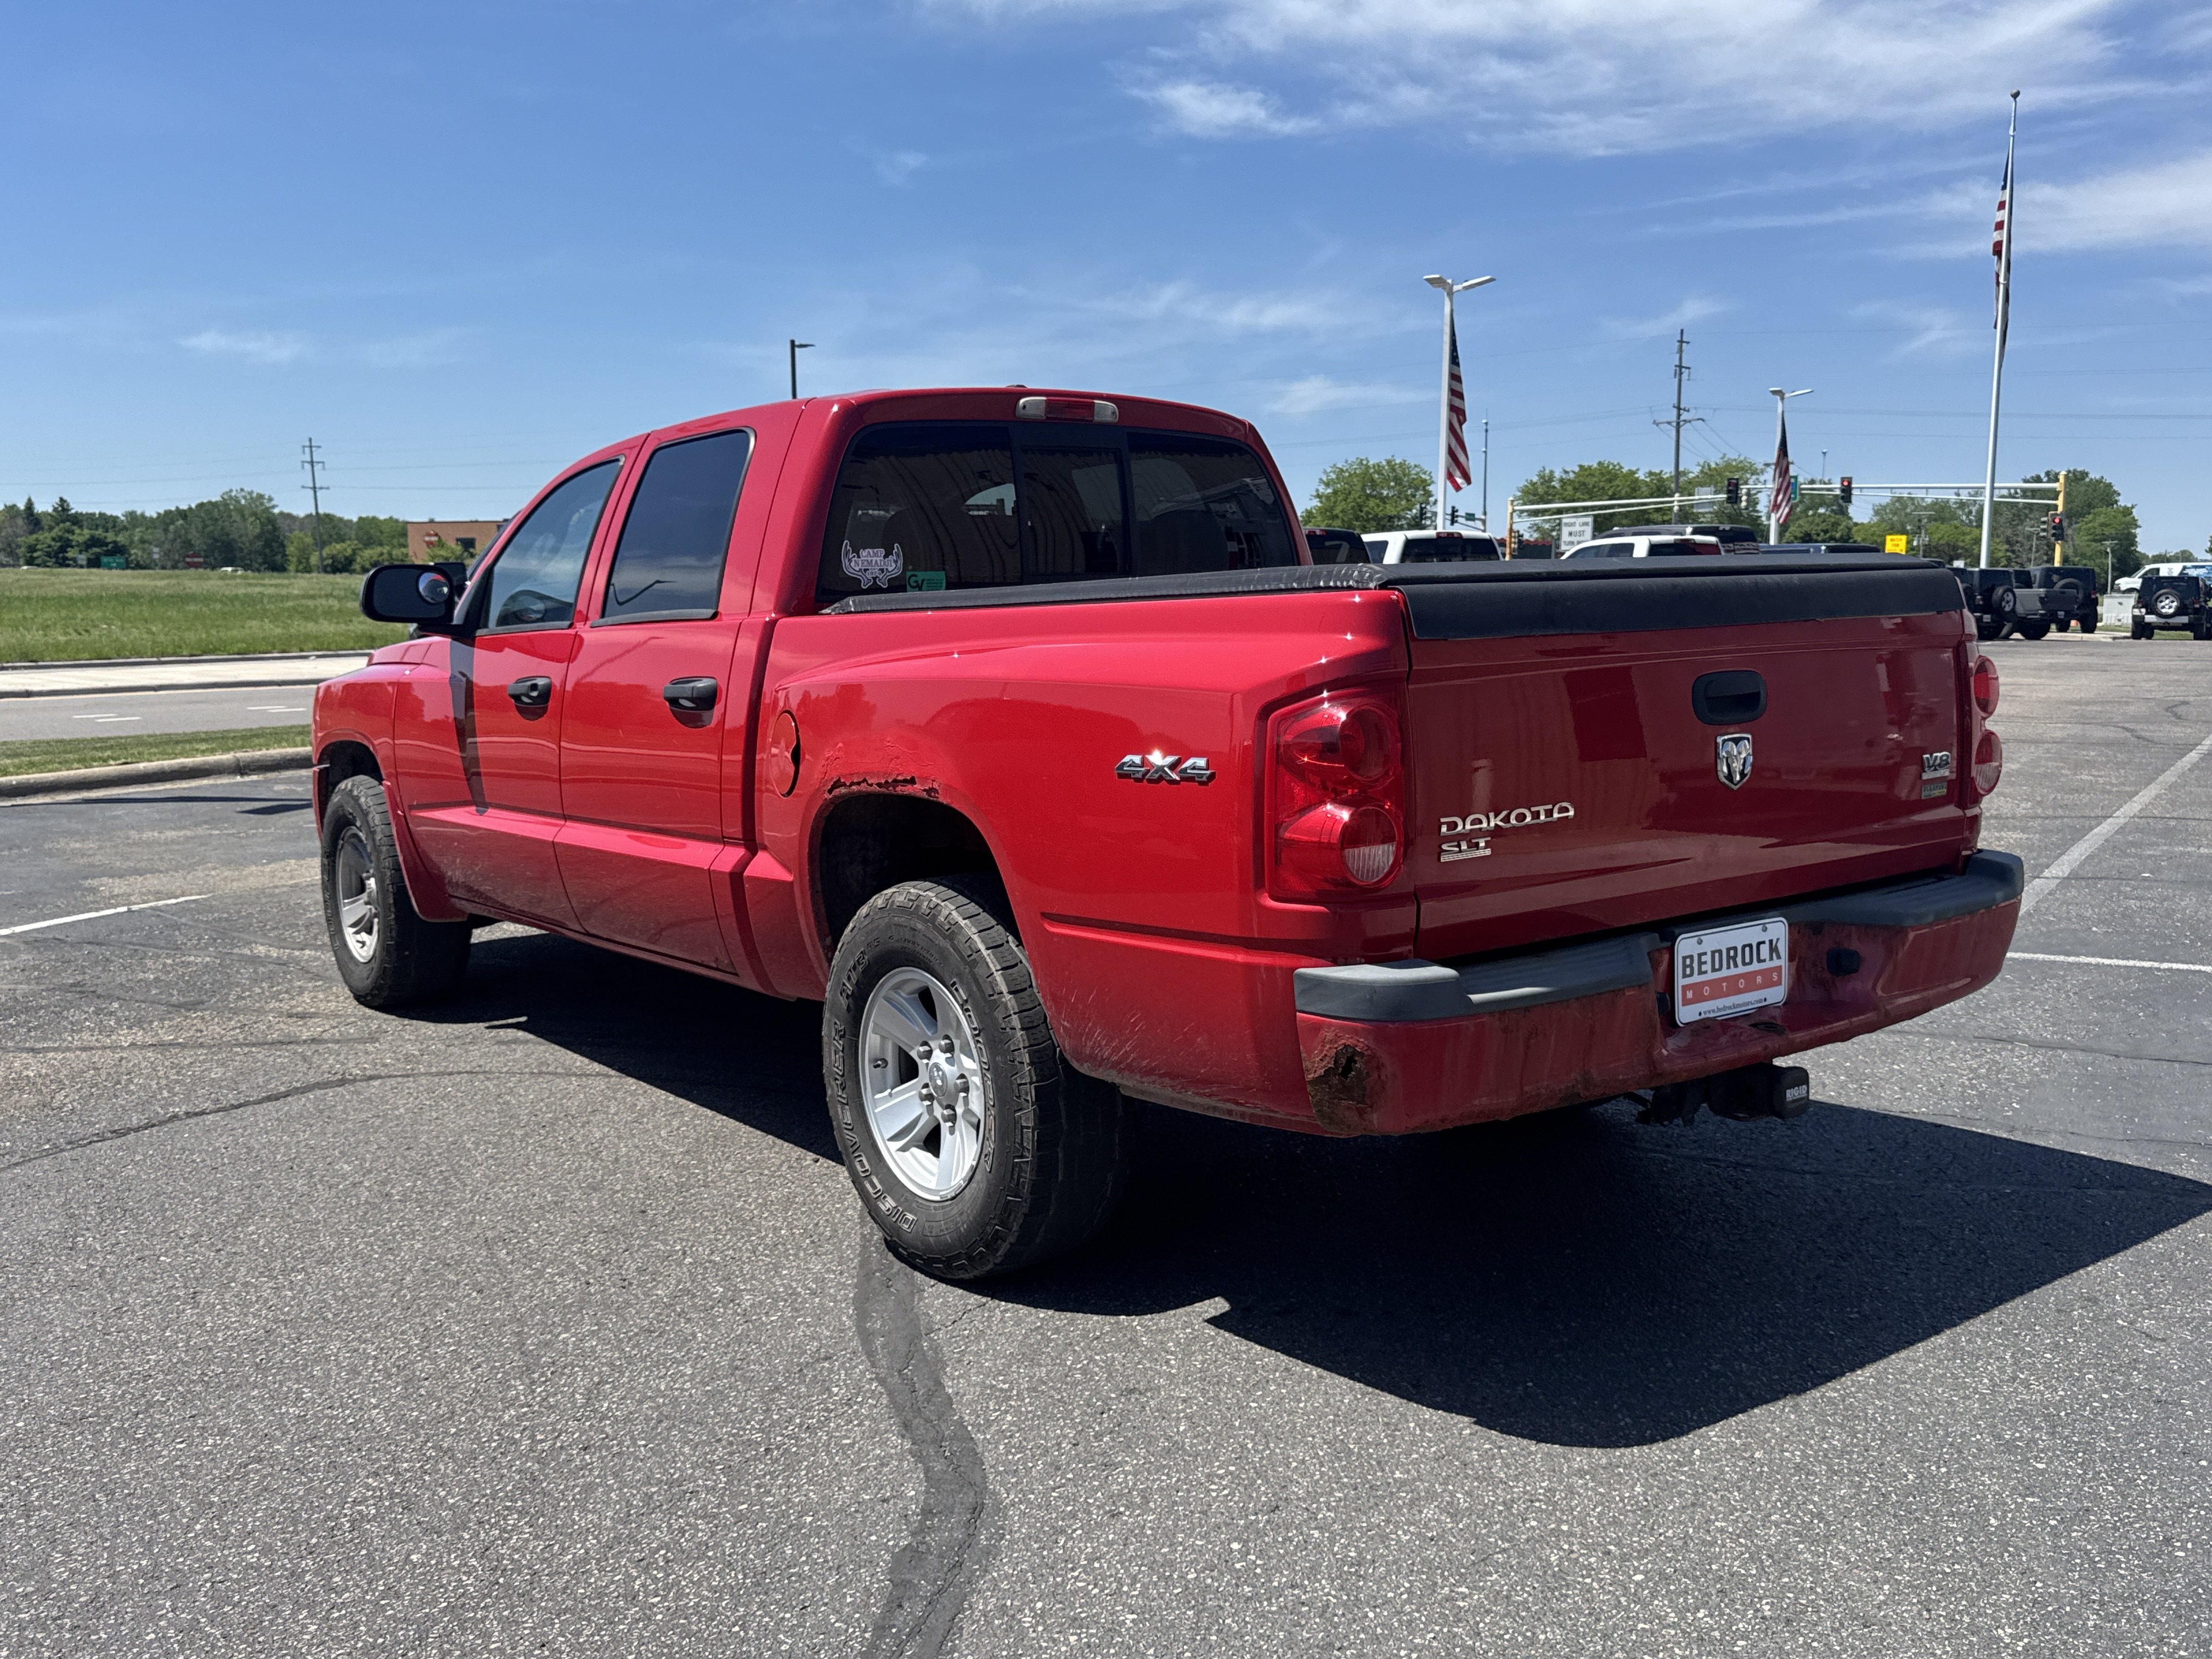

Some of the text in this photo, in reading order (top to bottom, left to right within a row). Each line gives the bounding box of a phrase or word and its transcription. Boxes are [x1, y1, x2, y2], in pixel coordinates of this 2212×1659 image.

[854, 559, 893, 567] NEMADJI
[861, 550, 884, 558] CAMP
[1922, 751, 1950, 772] V8
[1440, 802, 1575, 836] DAKOTA
[1440, 837, 1491, 854] SLT
[1681, 938, 1782, 979] BEDROCK
[1686, 972, 1778, 998] MOTORS
[1702, 998, 1763, 1015] www.bedrockmotors.com
[950, 978, 995, 1173] COOPER
[1786, 1085, 1808, 1098] RIGID
[832, 1019, 917, 1234] DISCOVERER
